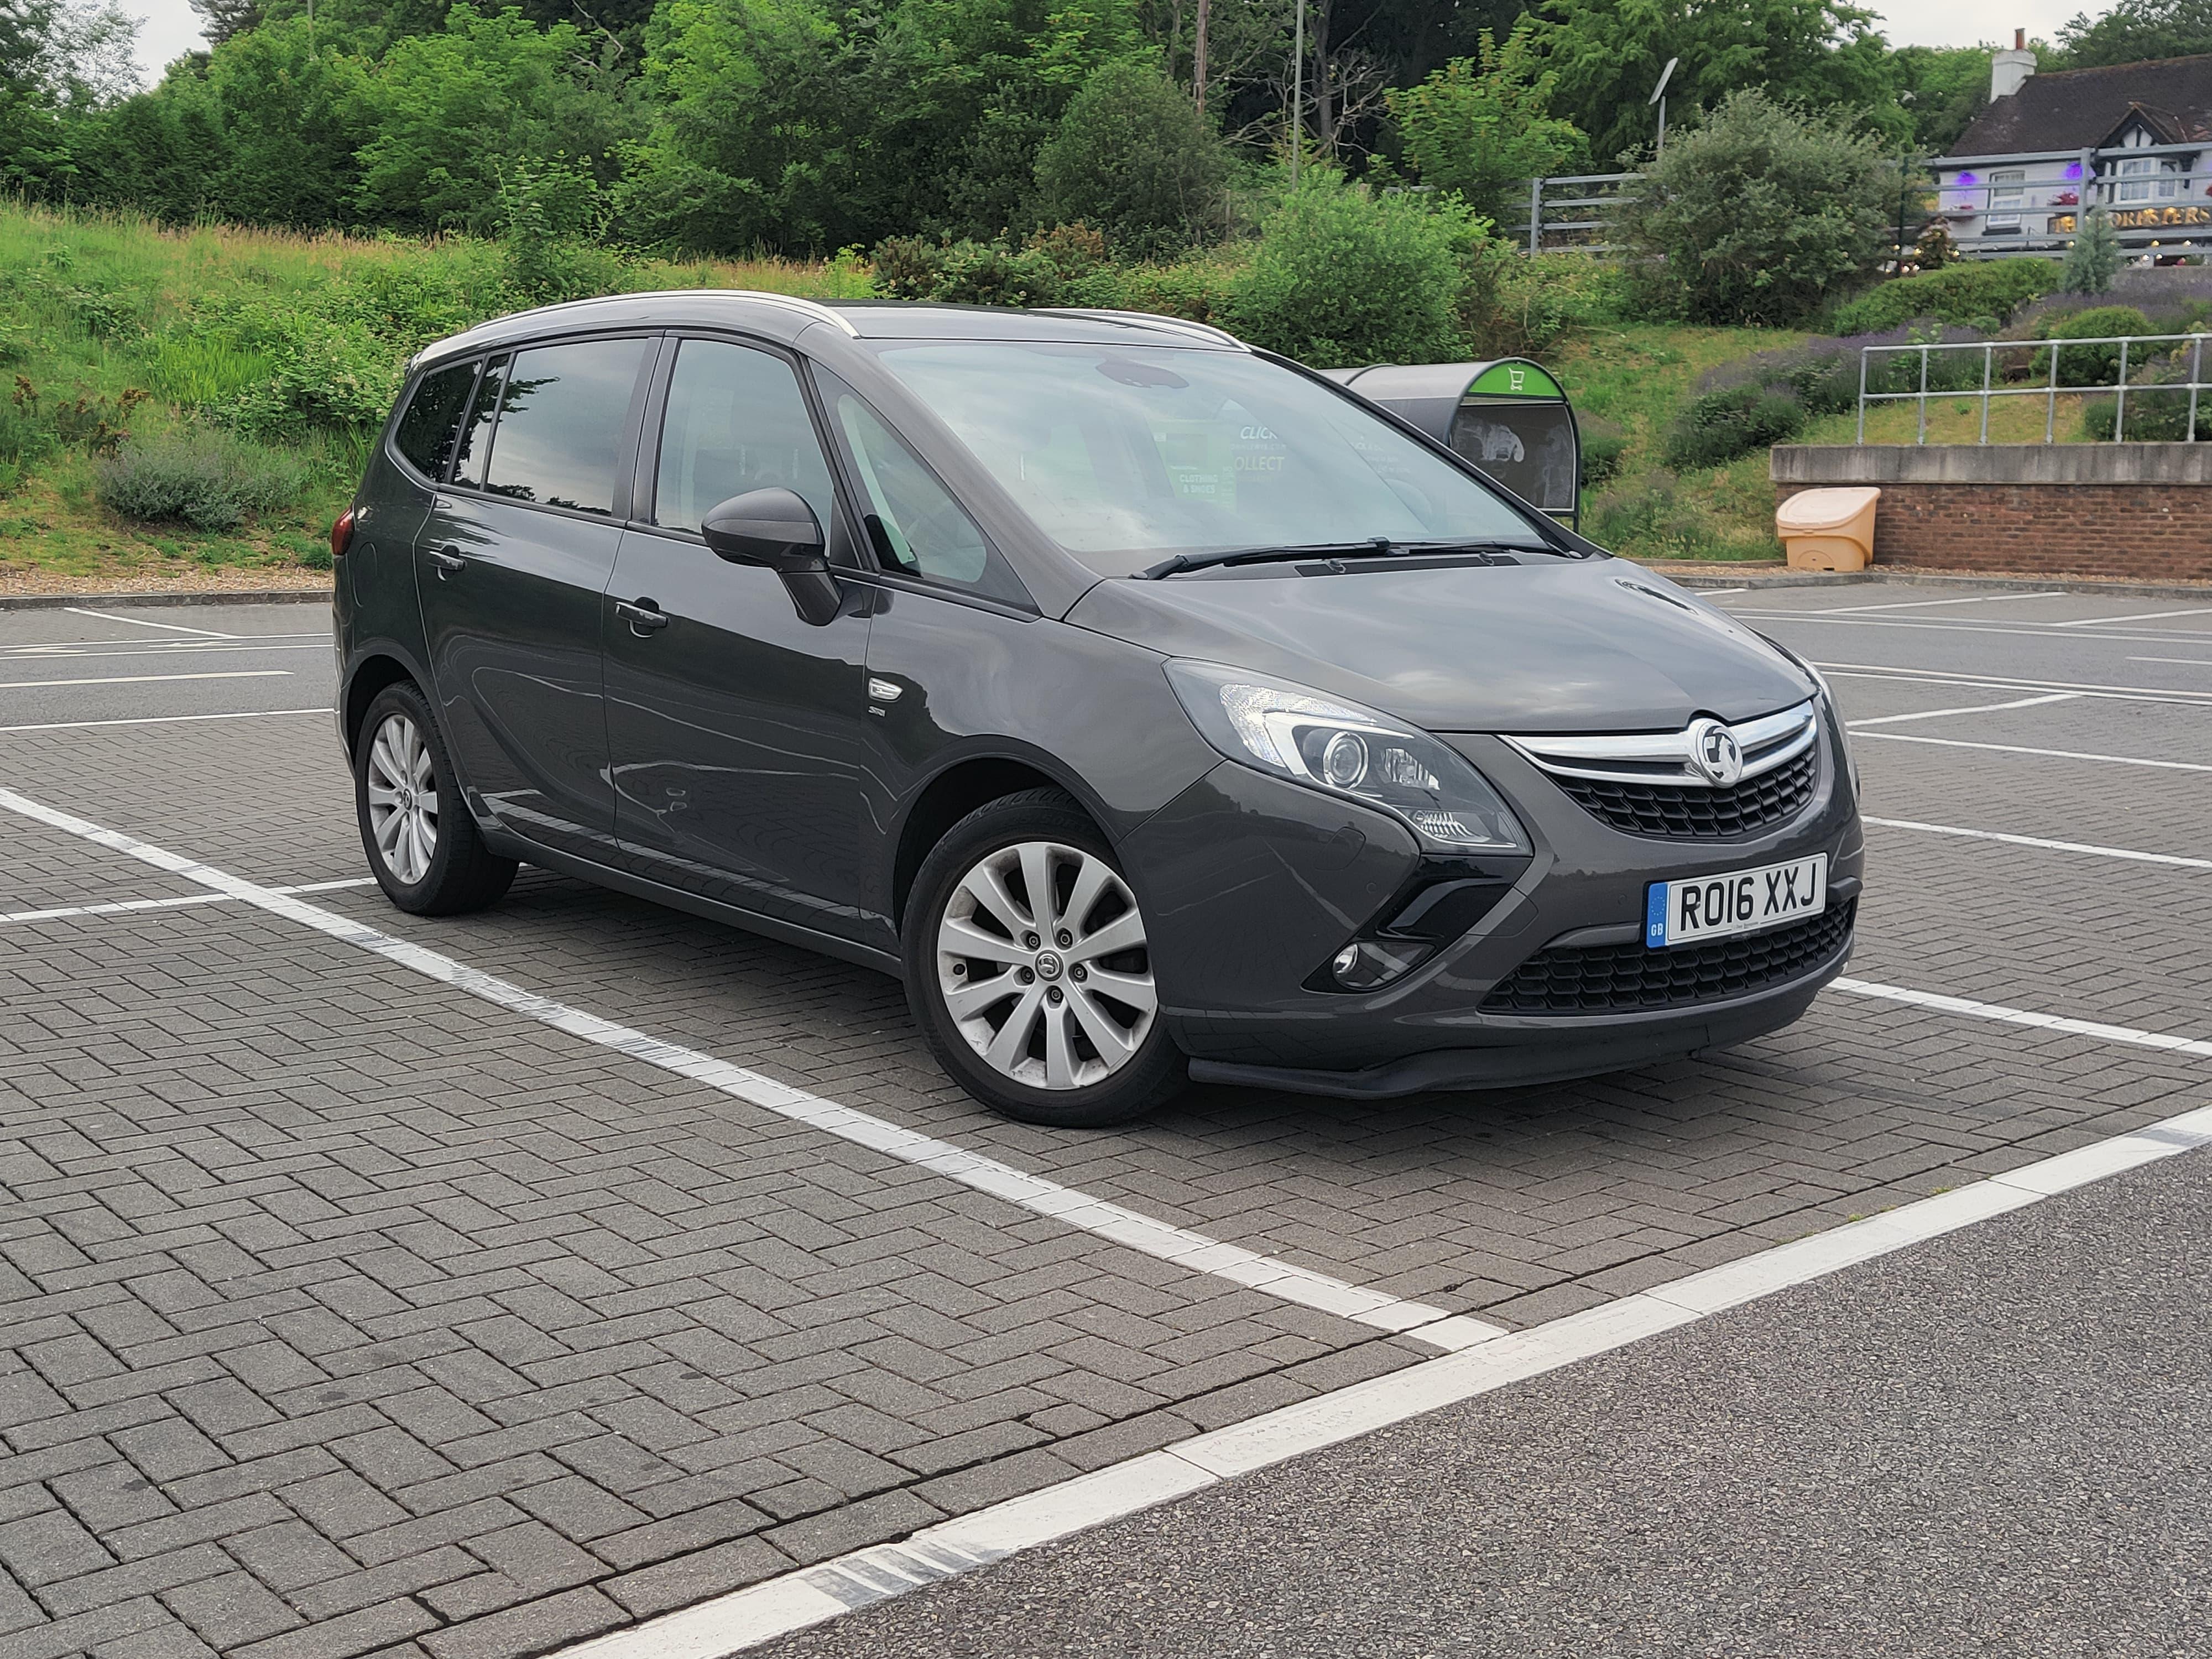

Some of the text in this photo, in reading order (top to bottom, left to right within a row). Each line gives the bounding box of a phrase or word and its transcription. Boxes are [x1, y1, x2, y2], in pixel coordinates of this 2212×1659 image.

[2106, 206, 2211, 228] ORESTERS
[1234, 456, 1285, 471] OLLECT
[1680, 863, 1817, 932] RO16 XXJ
[1651, 923, 1663, 936] GB
